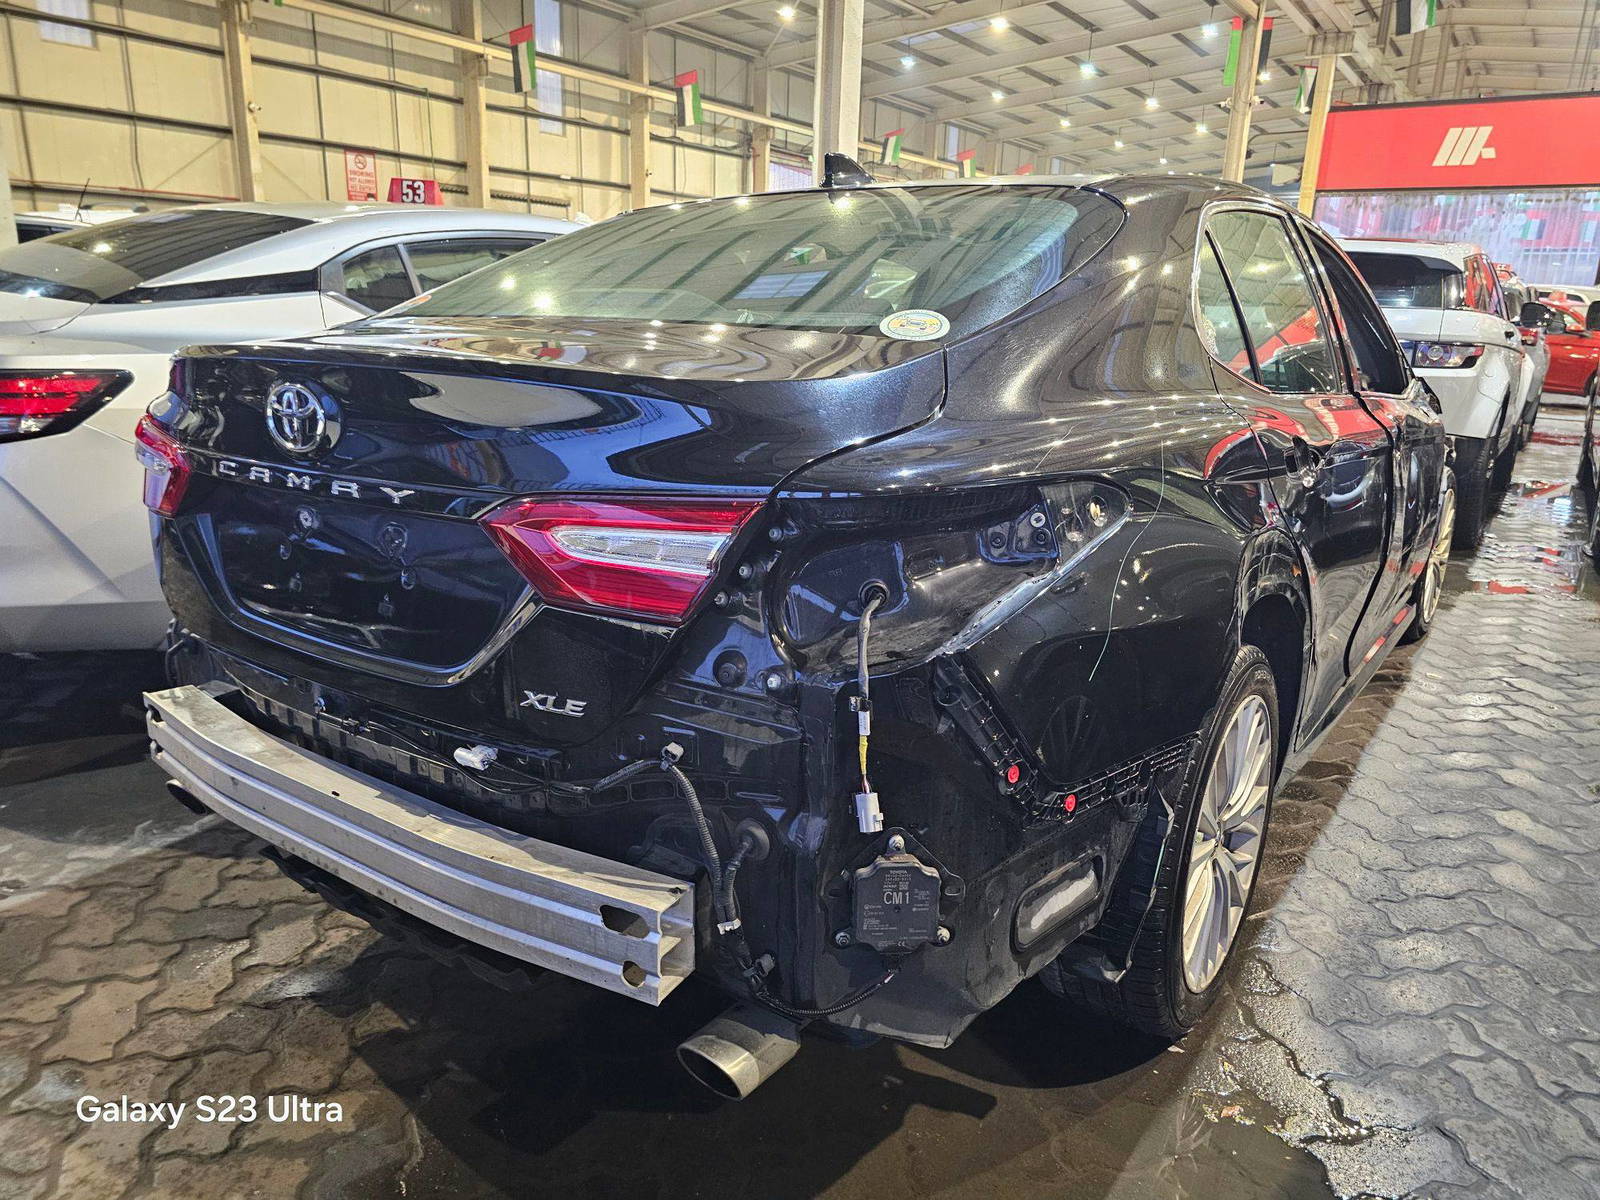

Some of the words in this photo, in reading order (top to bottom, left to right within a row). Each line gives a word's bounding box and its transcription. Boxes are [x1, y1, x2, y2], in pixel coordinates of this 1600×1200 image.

[402, 180, 425, 203] 53
[218, 460, 416, 505] CAMRY
[519, 690, 587, 718] XLE
